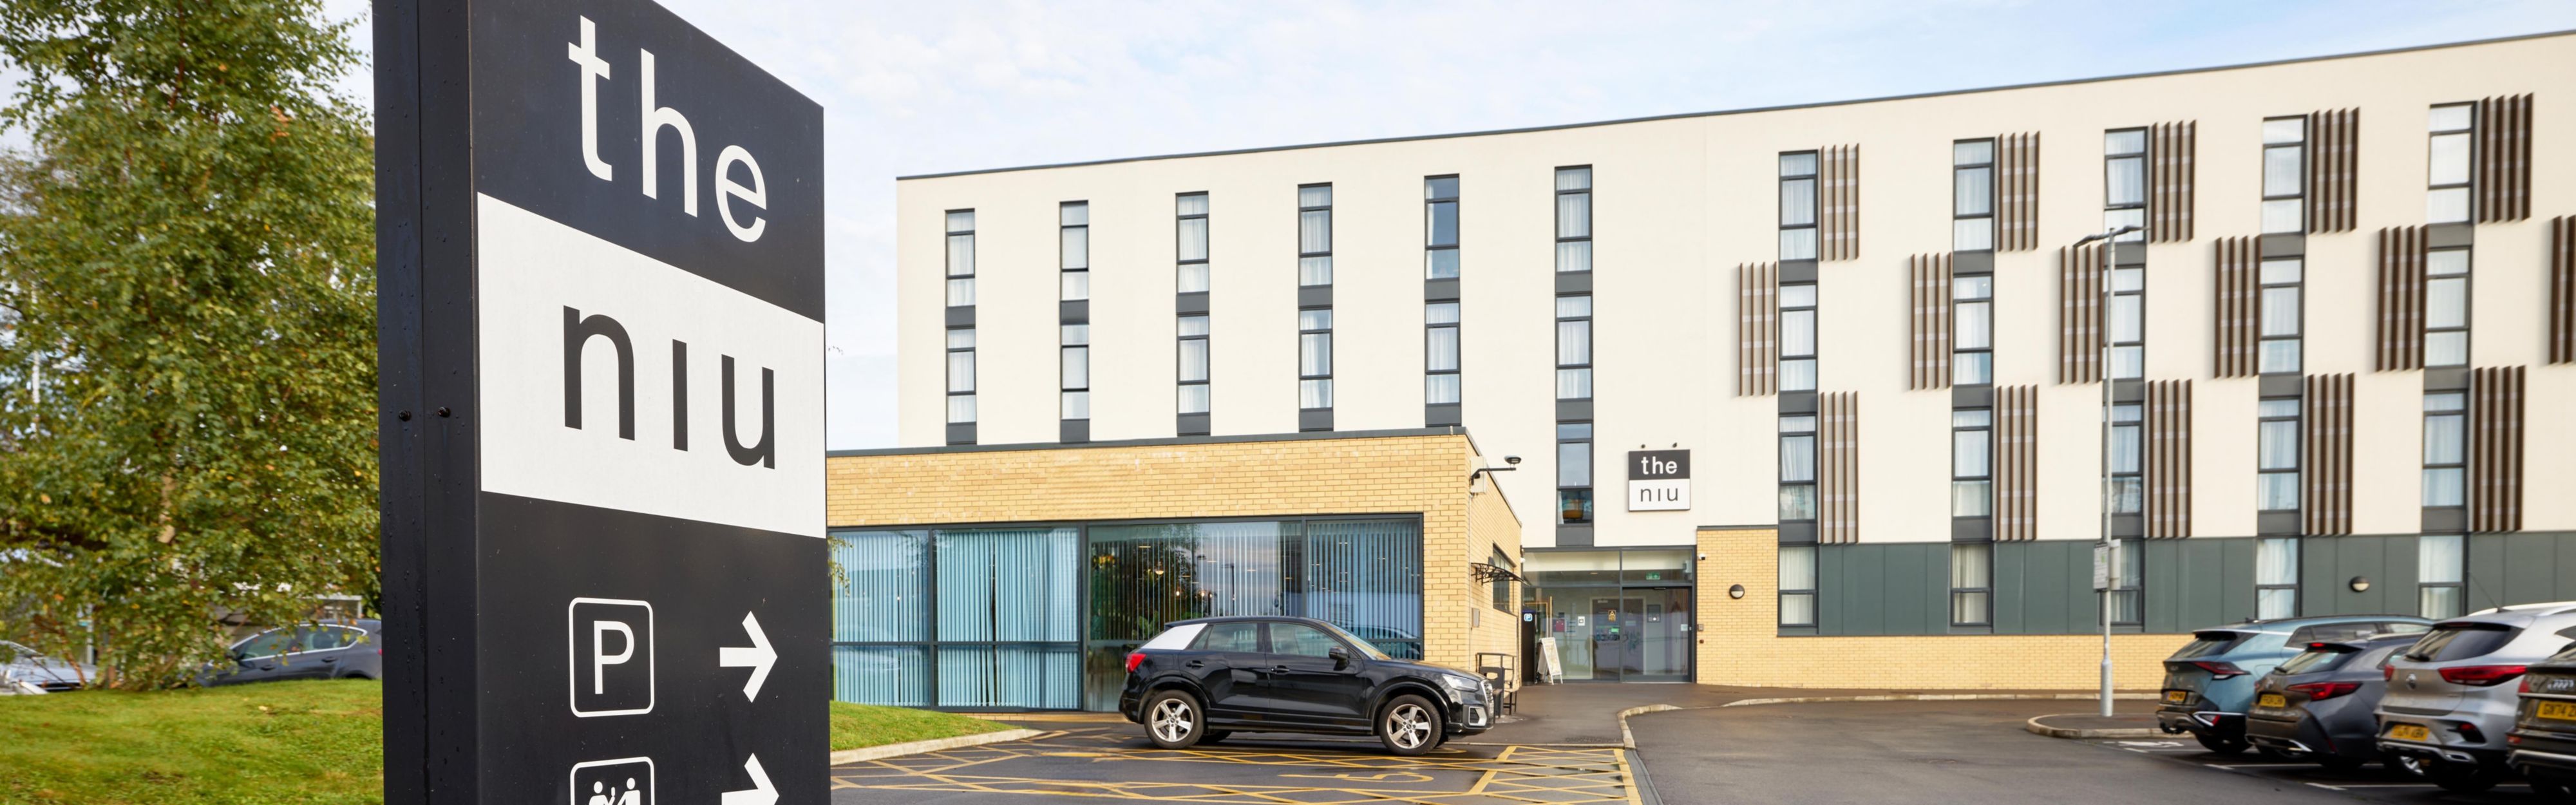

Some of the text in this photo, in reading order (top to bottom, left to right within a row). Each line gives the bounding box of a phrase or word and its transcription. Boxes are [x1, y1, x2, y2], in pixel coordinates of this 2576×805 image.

[568, 15, 767, 243] the
[564, 305, 775, 469] niu
[1640, 455, 1678, 475] the
[1640, 488, 1679, 502] niu
[593, 620, 635, 695] P
